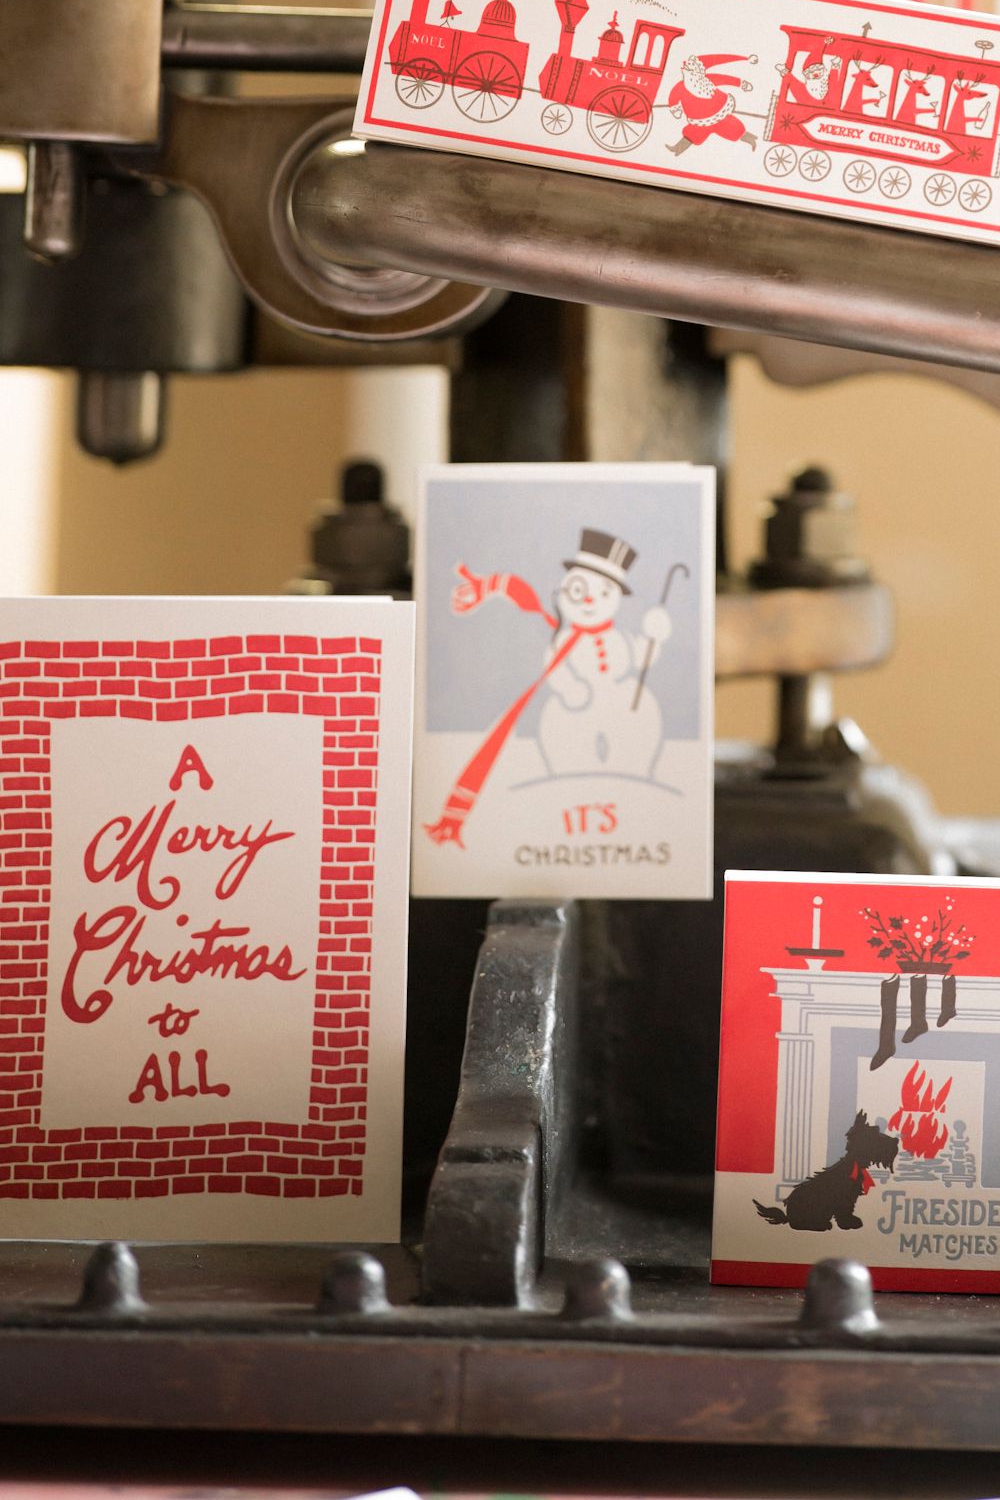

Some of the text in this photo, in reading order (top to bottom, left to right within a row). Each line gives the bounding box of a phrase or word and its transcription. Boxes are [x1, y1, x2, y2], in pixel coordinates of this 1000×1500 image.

[411, 32, 446, 49] NOEL
[588, 66, 649, 87] NOEL
[816, 123, 942, 155] MERRY CHRISTMAS
[168, 744, 214, 792] A
[83, 799, 296, 911] Merry
[513, 841, 673, 868] CHRISTMAS
[60, 905, 308, 1025] Christmas
[147, 1002, 200, 1038] to
[127, 1049, 231, 1104] ALL
[898, 1232, 999, 1261] MATCHES
